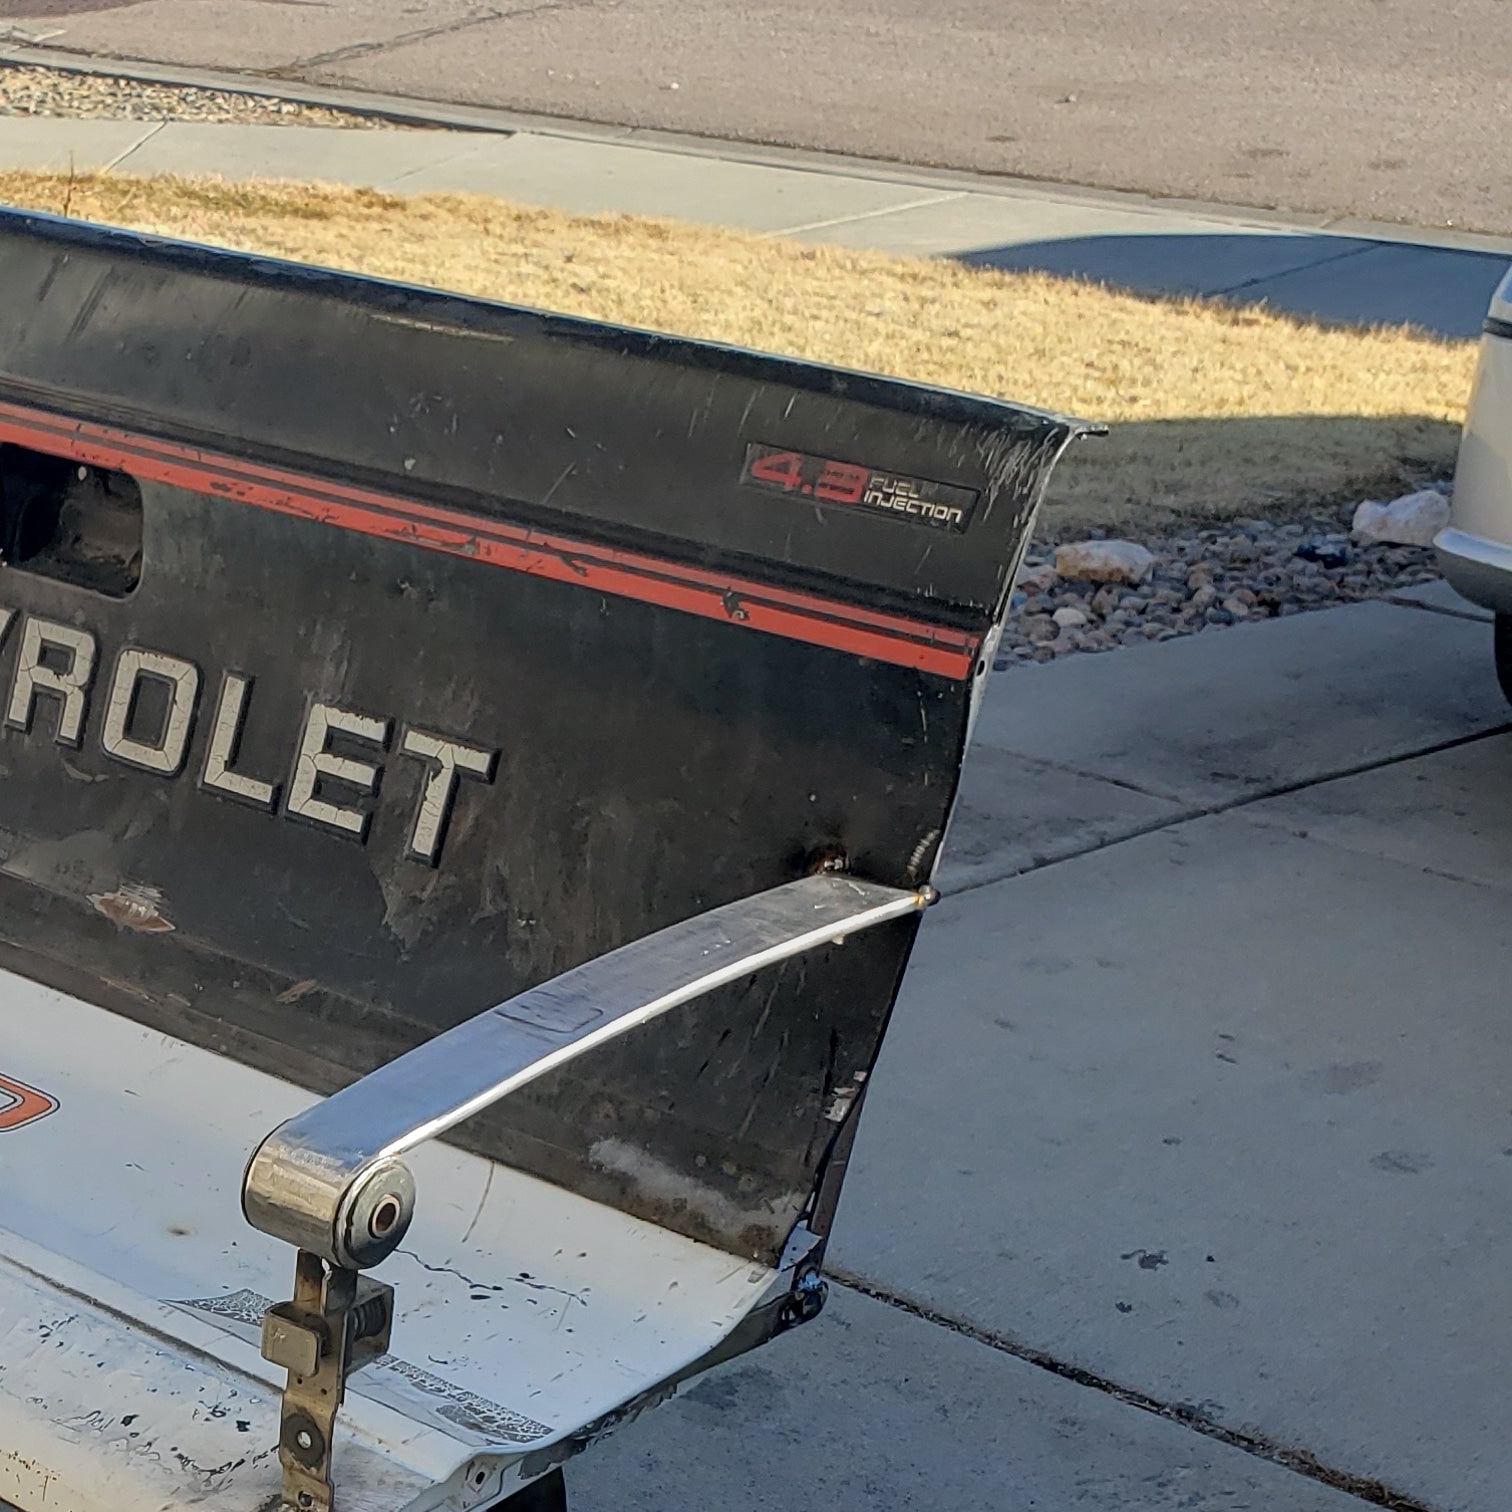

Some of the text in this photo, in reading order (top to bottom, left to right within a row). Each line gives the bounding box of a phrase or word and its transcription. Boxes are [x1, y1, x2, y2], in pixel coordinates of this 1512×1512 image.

[750, 452, 920, 504] 4.3 FUEL
[863, 490, 963, 523] INJECTION
